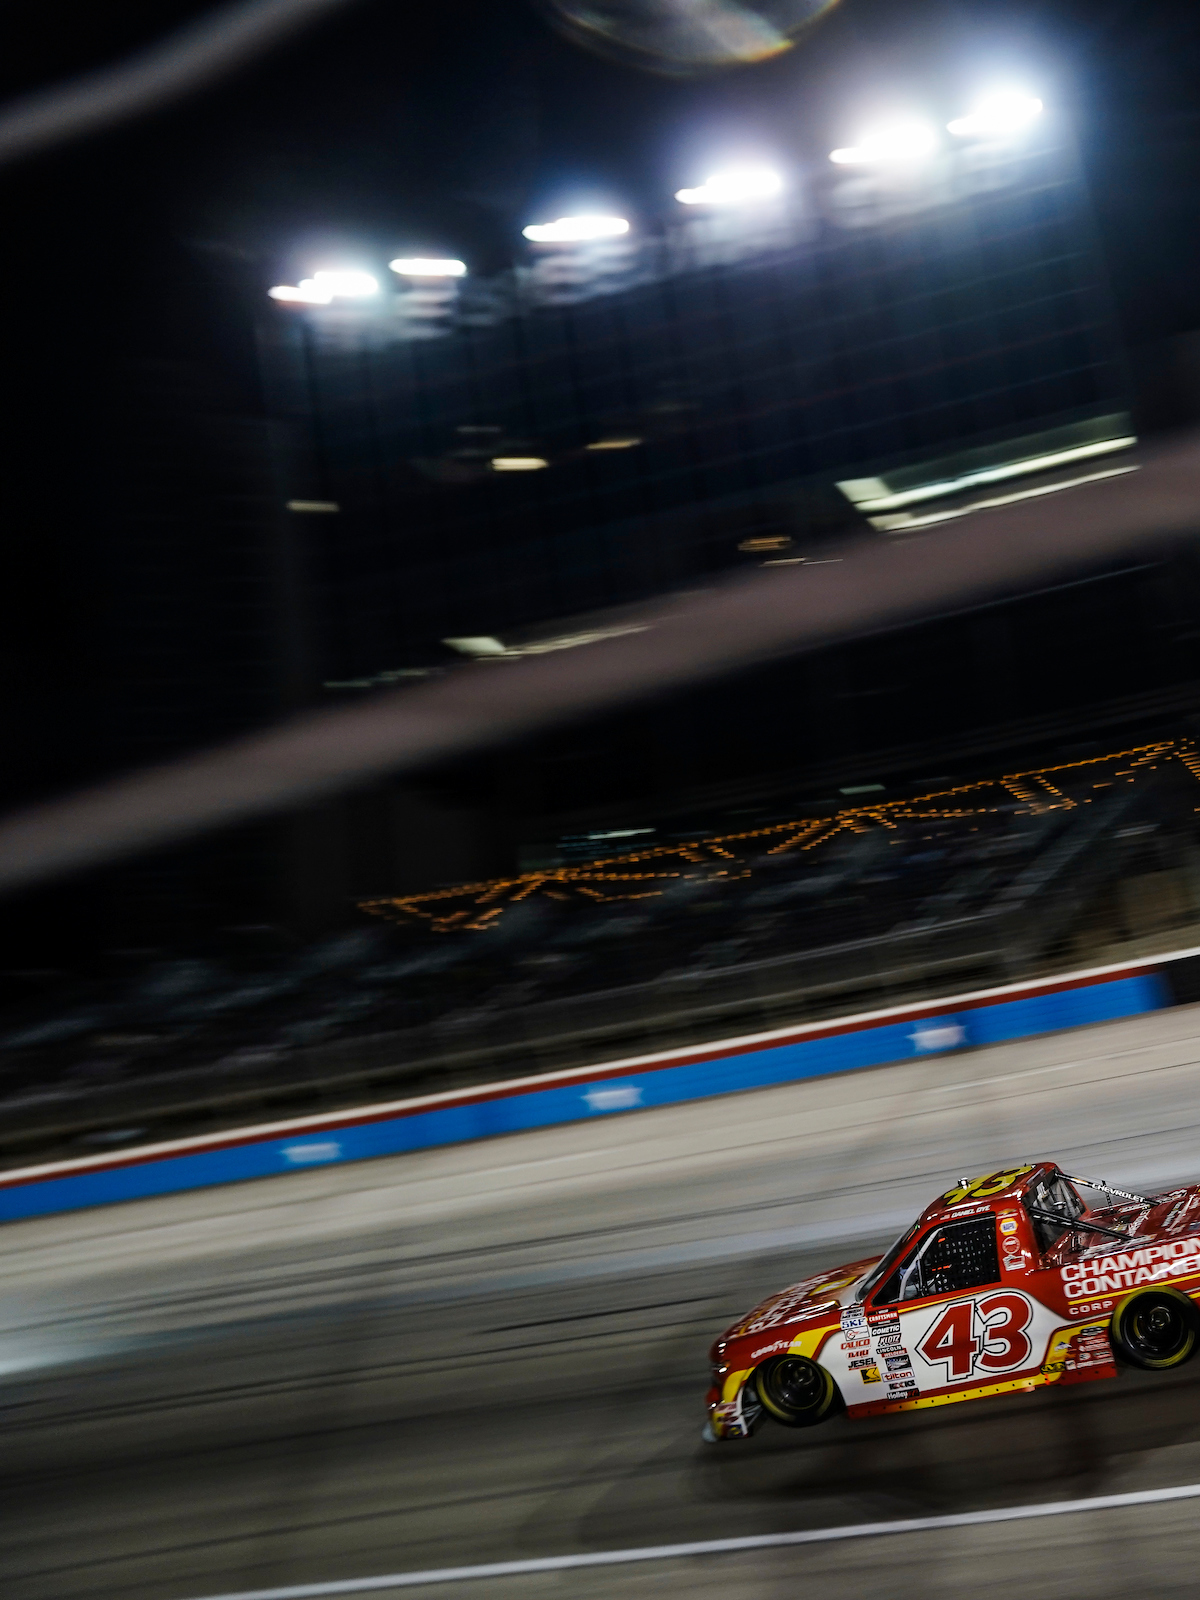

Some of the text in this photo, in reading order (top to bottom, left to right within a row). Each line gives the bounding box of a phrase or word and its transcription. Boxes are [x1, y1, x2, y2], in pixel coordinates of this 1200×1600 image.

[1092, 1182, 1145, 1203] CHEVROLET
[951, 1205, 991, 1218] DANIEL DYE
[1068, 1300, 1114, 1315] CORP
[842, 1317, 866, 1329] SKF
[869, 1312, 898, 1322] CRAFTSMAN
[872, 1325, 900, 1336] COMETIC
[915, 1292, 1032, 1381] 43
[841, 1339, 870, 1350] CALICO
[880, 1334, 901, 1344] KLOTZ
[751, 1340, 802, 1359] GOODYEAR
[848, 1357, 877, 1369] JESEL
[884, 1371, 912, 1380] tilton
[887, 1390, 908, 1400] Holley
